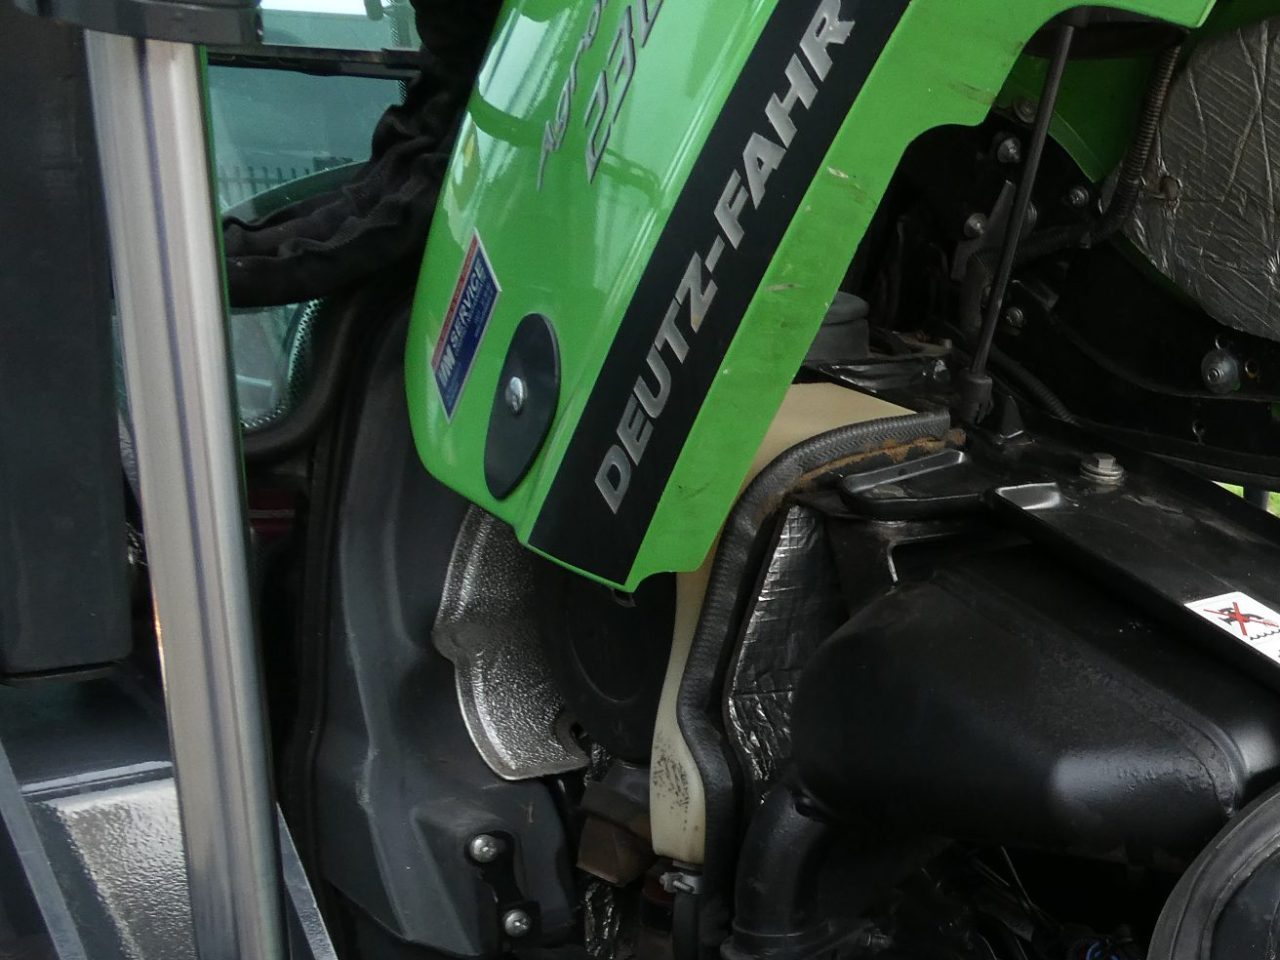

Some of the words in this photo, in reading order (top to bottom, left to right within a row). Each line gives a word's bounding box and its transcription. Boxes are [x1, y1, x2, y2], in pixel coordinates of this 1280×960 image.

[536, 0, 608, 192] Agro
[451, 257, 487, 349] SERVICE
[594, 0, 856, 514] DEUTZ-FAHR
